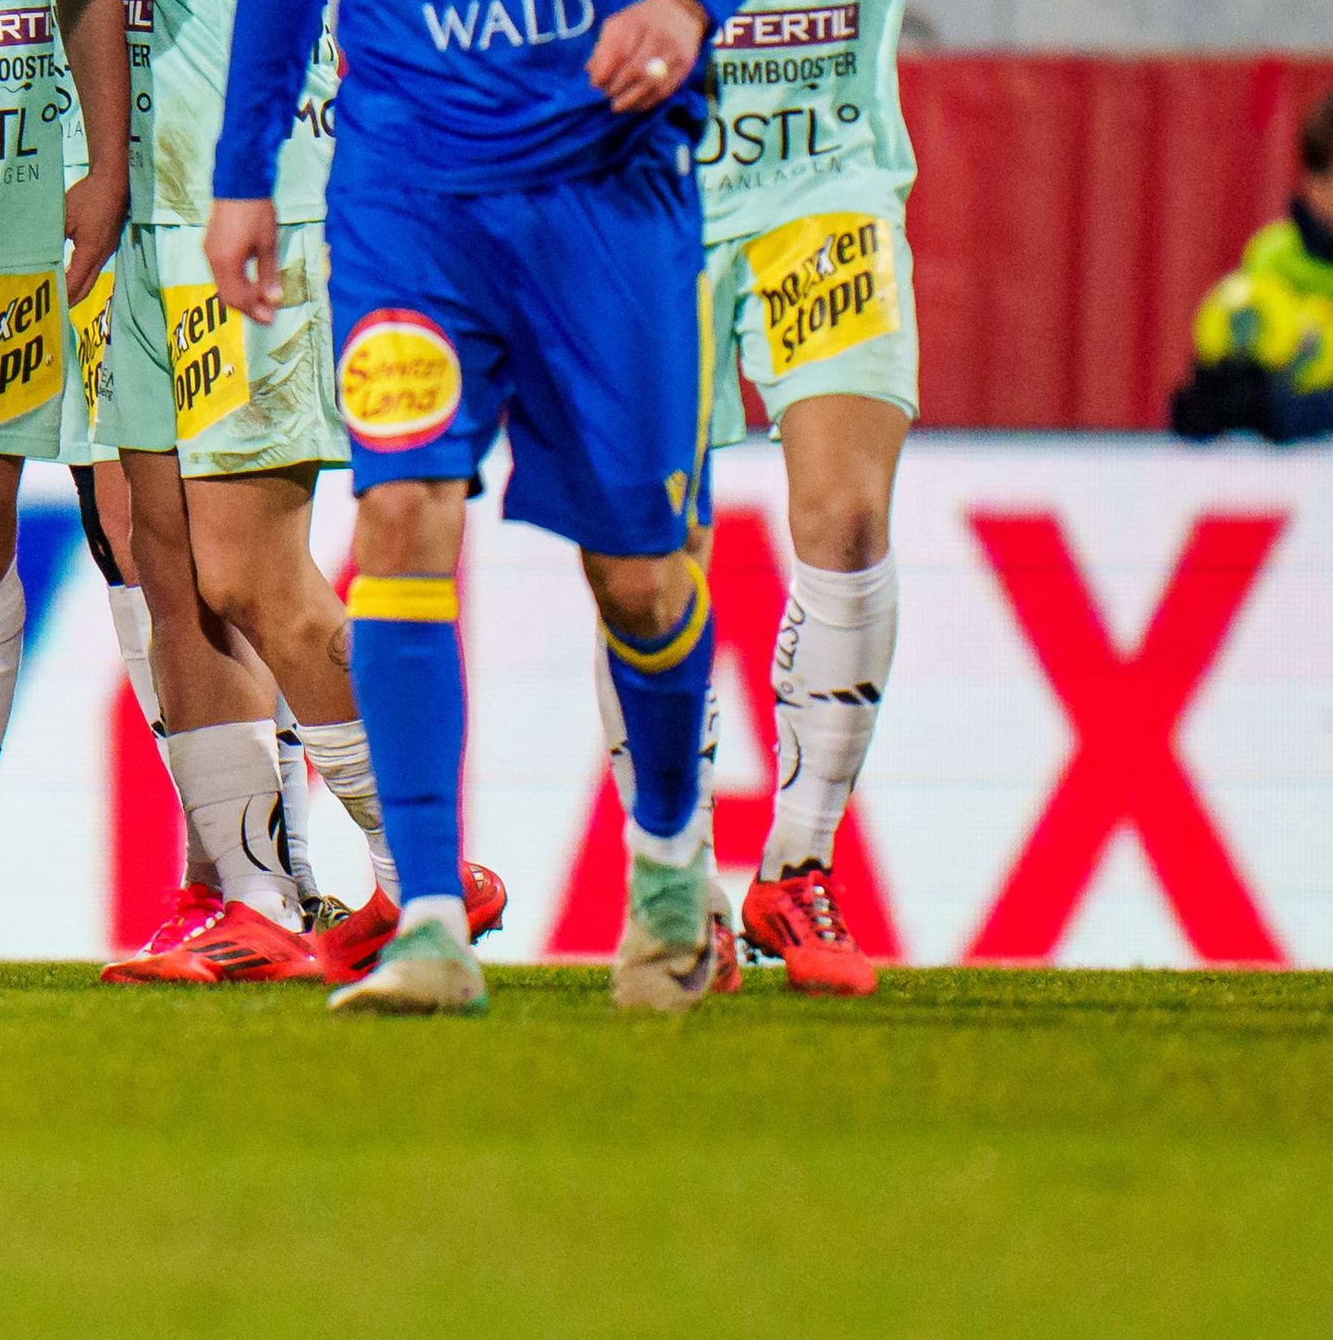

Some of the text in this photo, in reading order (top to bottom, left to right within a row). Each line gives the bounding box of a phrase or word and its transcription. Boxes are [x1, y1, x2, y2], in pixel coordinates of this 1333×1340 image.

[719, 51, 858, 85] RMBOOSTER
[760, 221, 879, 329] boxxen
[780, 269, 875, 363] stopp
[175, 344, 222, 412] opp
